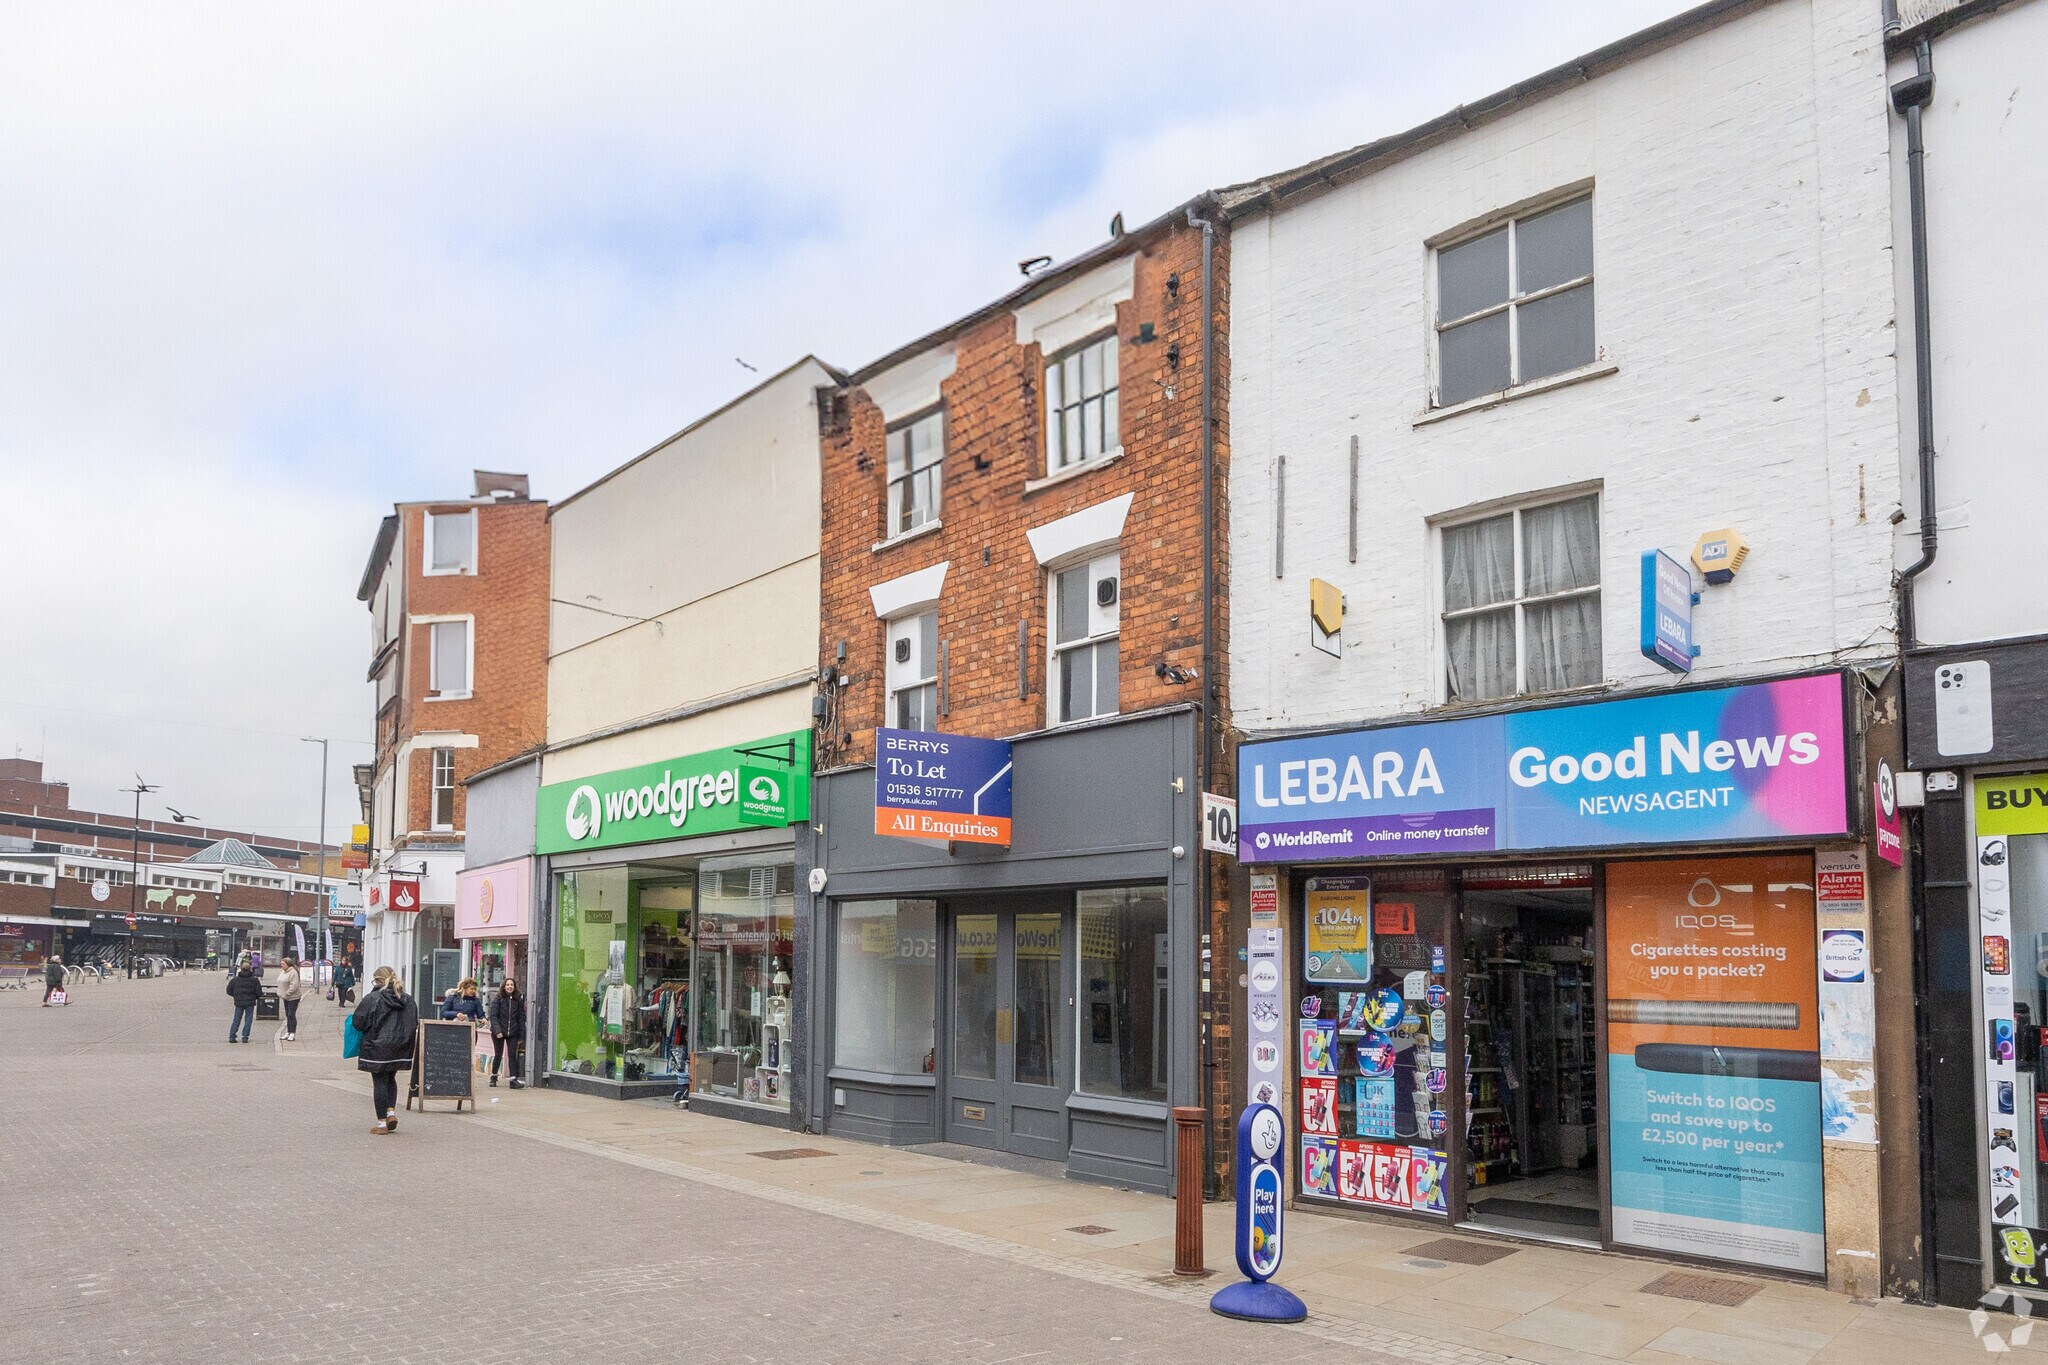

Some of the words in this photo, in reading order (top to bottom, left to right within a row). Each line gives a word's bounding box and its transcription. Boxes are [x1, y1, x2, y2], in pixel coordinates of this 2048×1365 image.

[1702, 542, 1727, 559] ADT
[1660, 613, 1687, 645] LEBARA
[887, 738, 949, 754] BERRYS
[887, 757, 913, 776] To
[917, 760, 946, 779] Let
[1509, 736, 1646, 788] Good
[1660, 730, 1820, 775] News
[1255, 747, 1444, 807] LEBARA
[605, 768, 738, 828] woodgree
[887, 783, 921, 795] 01536
[925, 786, 964, 799] 517777
[1986, 788, 2048, 810] BUY
[743, 801, 785, 814] woodgreen
[886, 795, 938, 806] berrys.uk.com
[1579, 786, 1734, 816] NEWSAGENT
[891, 814, 915, 831] All
[921, 816, 998, 837] Enquiries
[1366, 831, 1402, 842] Online
[1404, 829, 1442, 842] money
[1443, 825, 1490, 837] transfer
[1273, 828, 1353, 847] WorldRemit
[1879, 827, 1900, 849] payzone
[1820, 873, 1862, 883] Alarm
[1675, 915, 1735, 929] IQOS
[1630, 943, 1718, 960] Cigarettes
[1721, 943, 1787, 961] costing
[1650, 965, 1679, 979] you
[1683, 965, 1693, 976] a
[1697, 963, 1766, 979] packet?
[1646, 1090, 1702, 1106] Switch
[1706, 1095, 1725, 1108] to
[1730, 1096, 1776, 1113] IQOS
[1651, 1111, 1681, 1124] and
[1685, 1116, 1724, 1128] save
[1728, 1120, 1749, 1134] up
[1753, 1119, 1773, 1133] to
[1642, 1128, 1698, 1145] £2,500
[1702, 1136, 1730, 1150] per
[1642, 1156, 1663, 1164] Switch
[1689, 1161, 1713, 1169] harmful
[1714, 1164, 1749, 1173] alternative
[1708, 1171, 1723, 1179] price
[1255, 1189, 1274, 1203] Play
[1255, 1203, 1274, 1214] here
